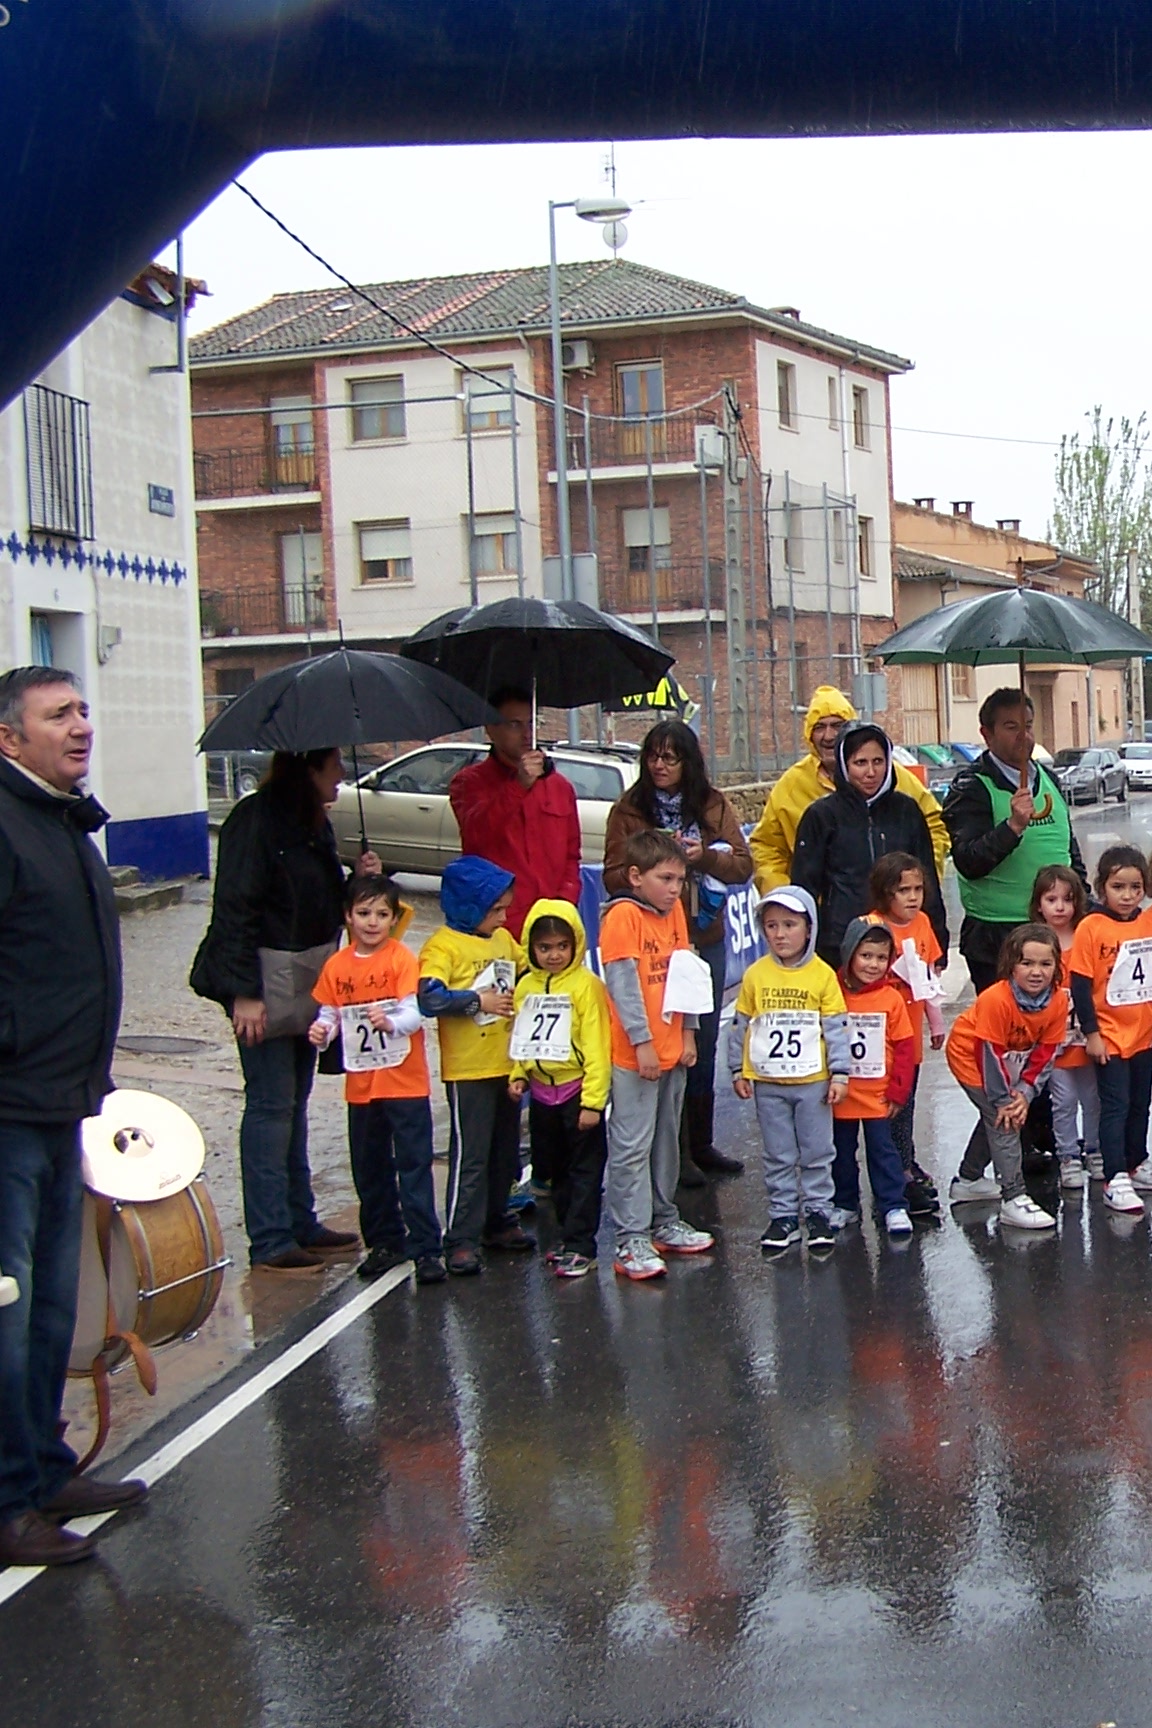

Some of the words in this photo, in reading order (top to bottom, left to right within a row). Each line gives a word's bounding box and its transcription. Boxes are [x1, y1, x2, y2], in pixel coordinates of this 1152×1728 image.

[1132, 957, 1146, 985] 4
[356, 1024, 387, 1053] 21
[530, 1013, 561, 1041] 27
[768, 1030, 801, 1059] 25
[850, 1032, 866, 1060] 6
